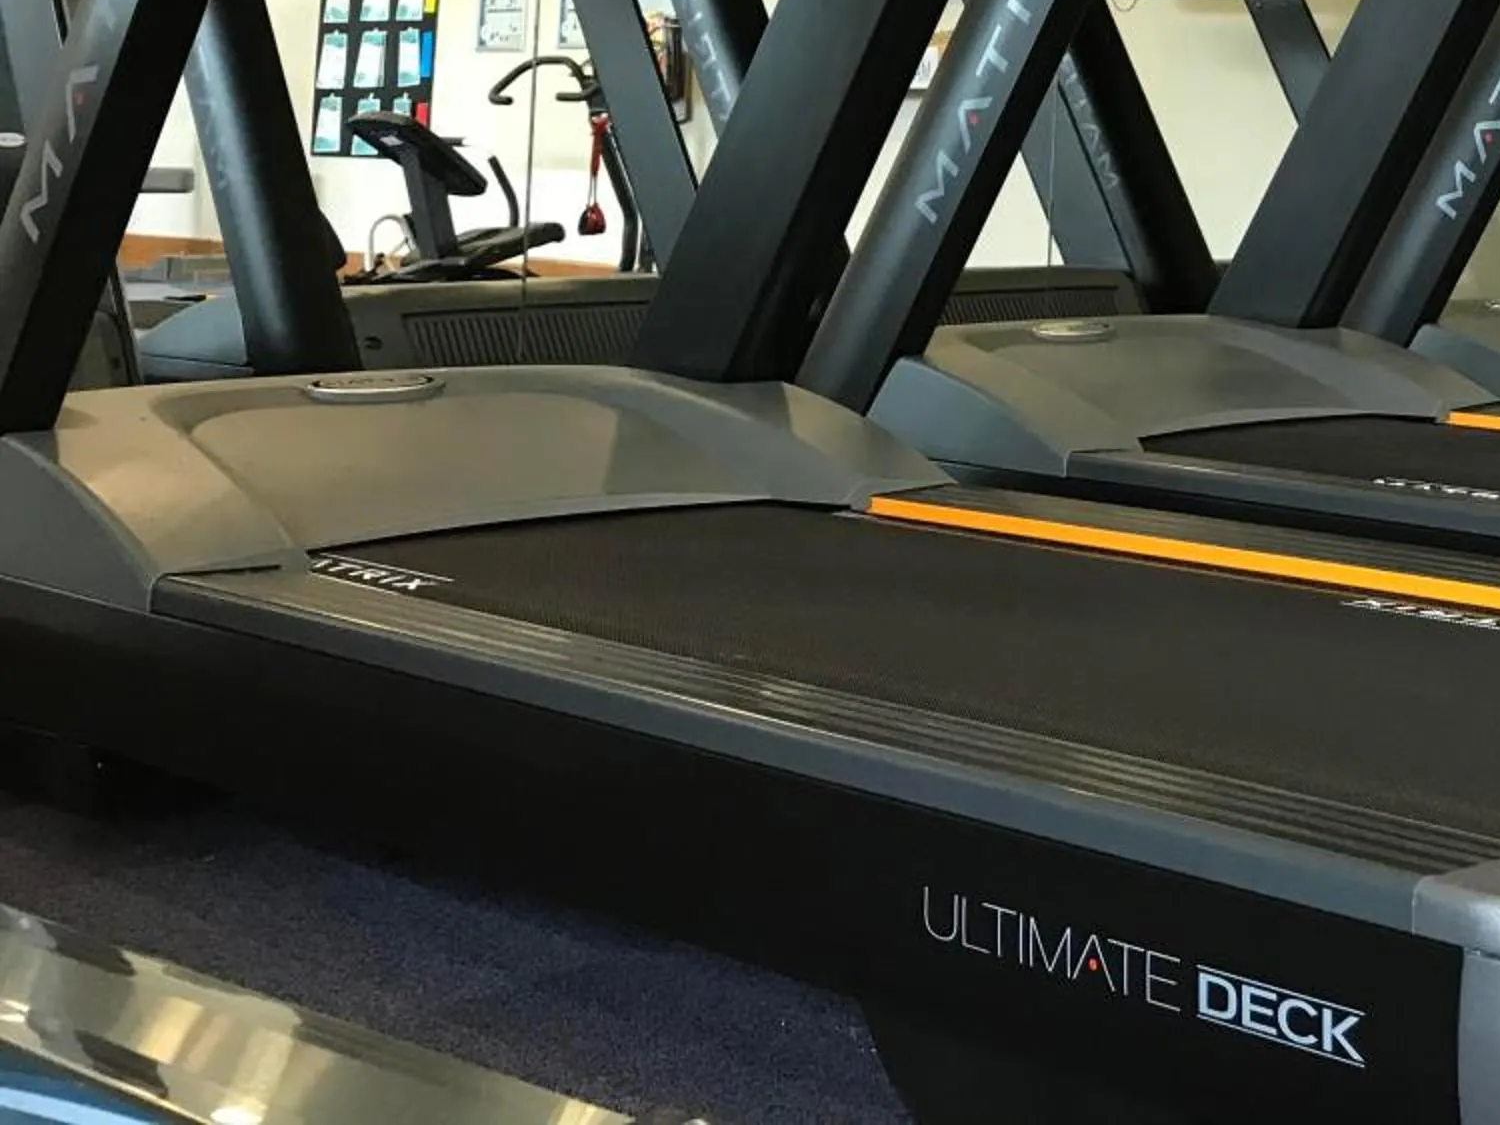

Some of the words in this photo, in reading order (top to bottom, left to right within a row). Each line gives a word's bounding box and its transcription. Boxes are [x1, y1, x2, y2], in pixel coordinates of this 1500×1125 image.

[312, 559, 438, 591] TRIX
[923, 886, 1181, 1011] ULTIMATE
[1197, 969, 1364, 1062] DECK
